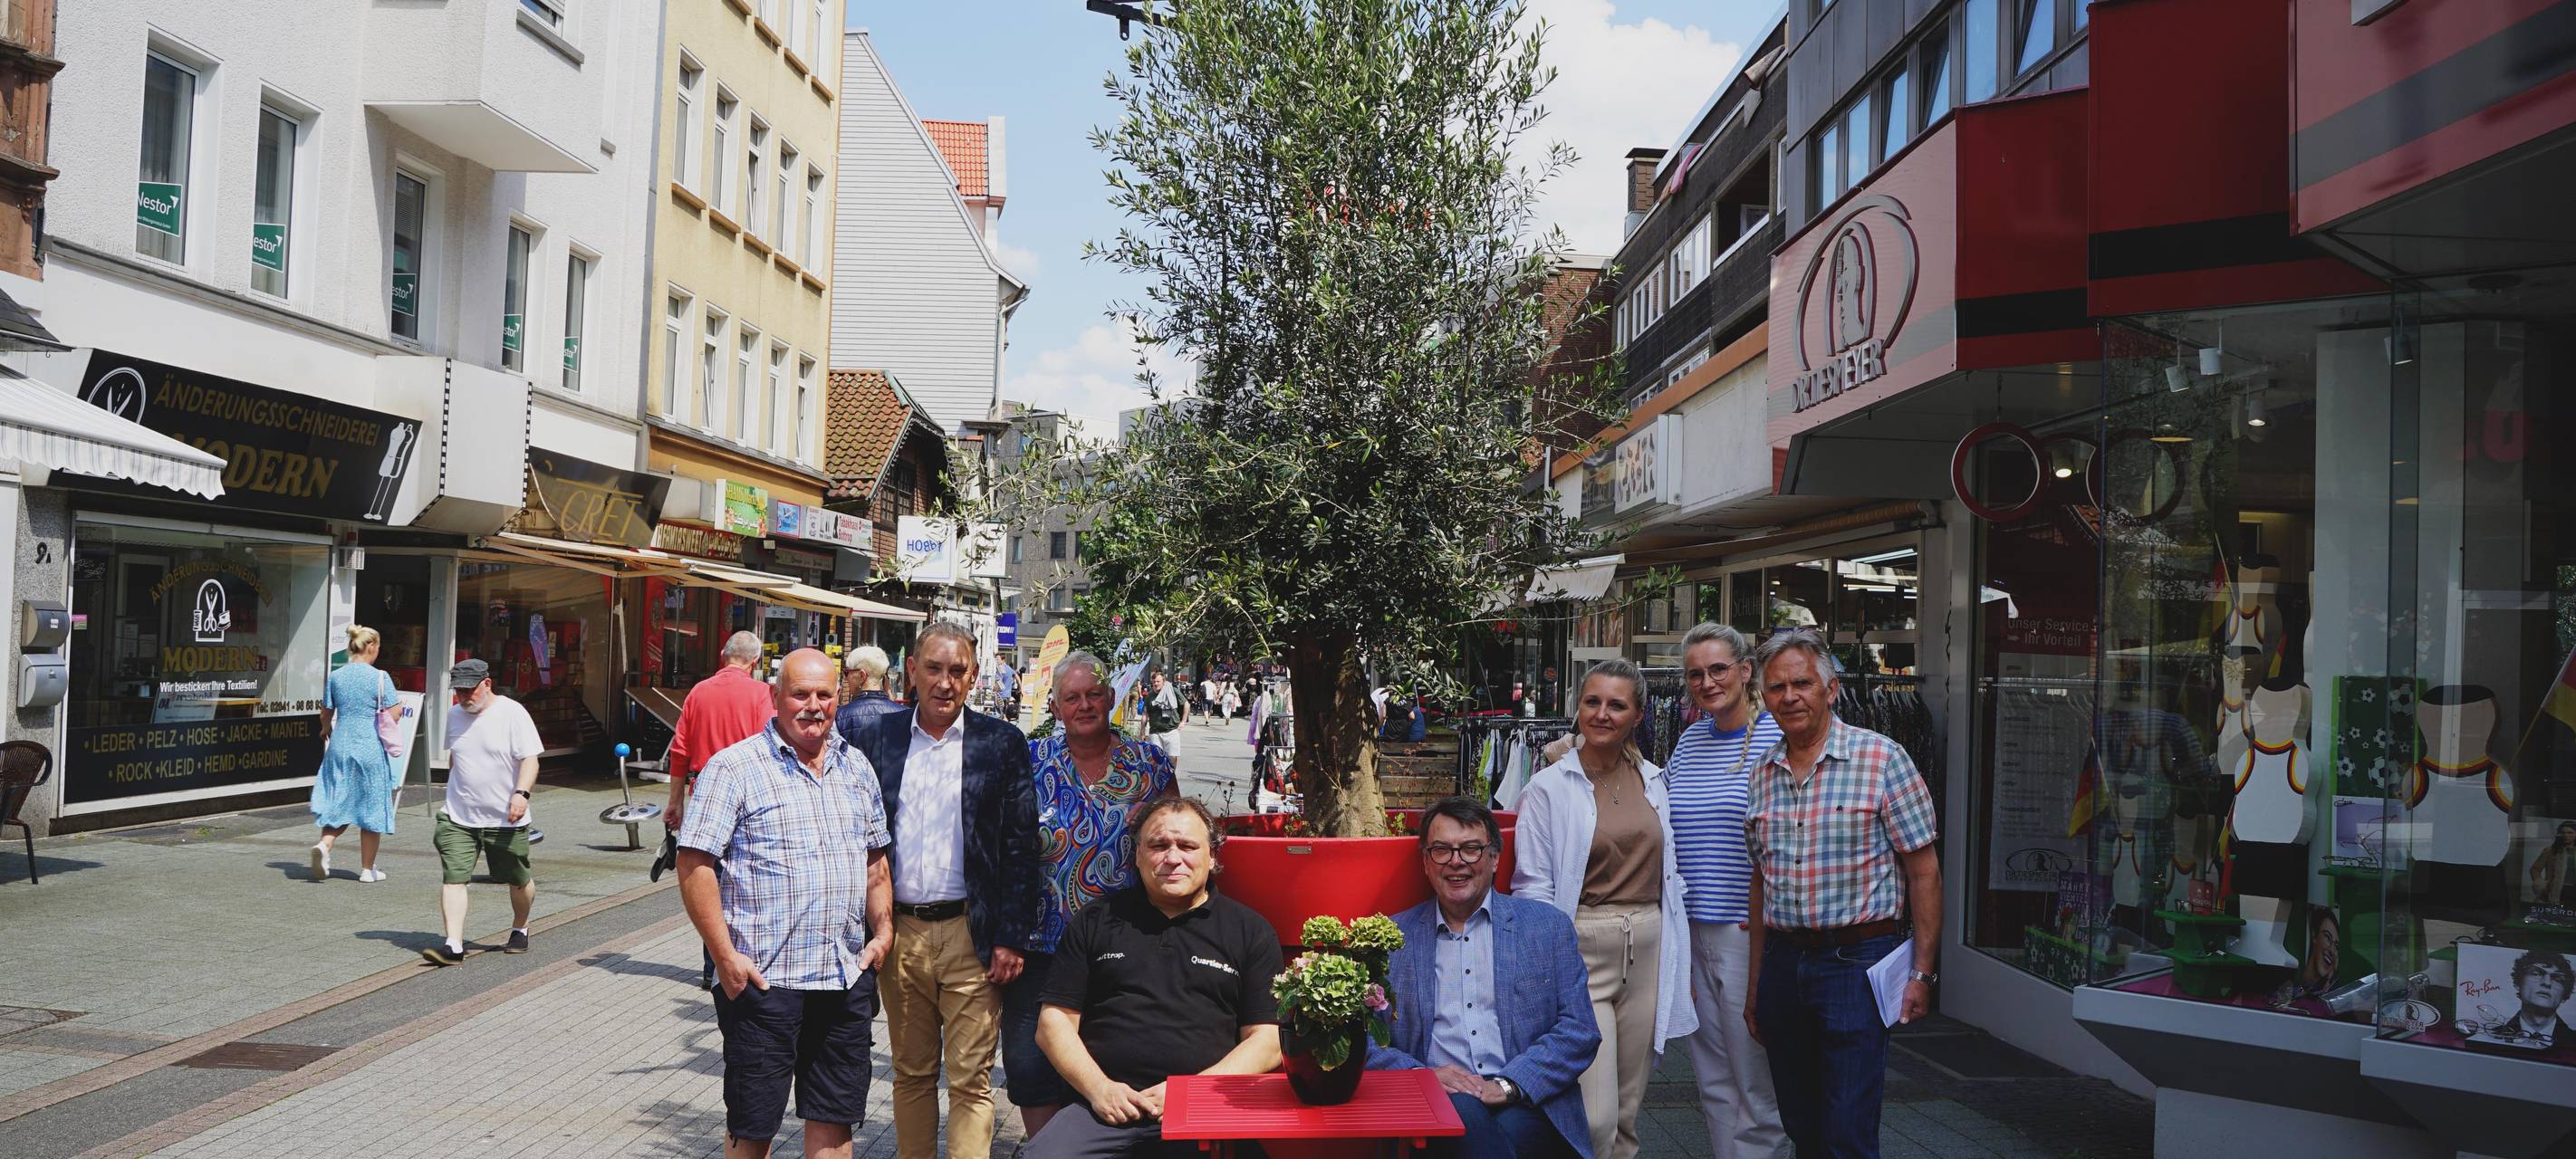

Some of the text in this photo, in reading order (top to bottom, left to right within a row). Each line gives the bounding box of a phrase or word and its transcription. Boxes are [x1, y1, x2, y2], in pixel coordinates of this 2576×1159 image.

[152, 372, 380, 446] ÄNDERUNGSSCHNEIDEREI
[170, 433, 340, 499] DERN
[2044, 618, 2090, 632] Service
[2043, 633, 2081, 647] Vorteil
[162, 646, 260, 673] MODERN
[159, 679, 257, 694] Wir besticken Ihre Textilien!
[92, 721, 311, 753] LEDER PELZ HOSE JACKE MANTEL
[116, 750, 288, 783] ROCK KLEID HEMD GARDINE
[2459, 978, 2501, 997] Ray-Ban
